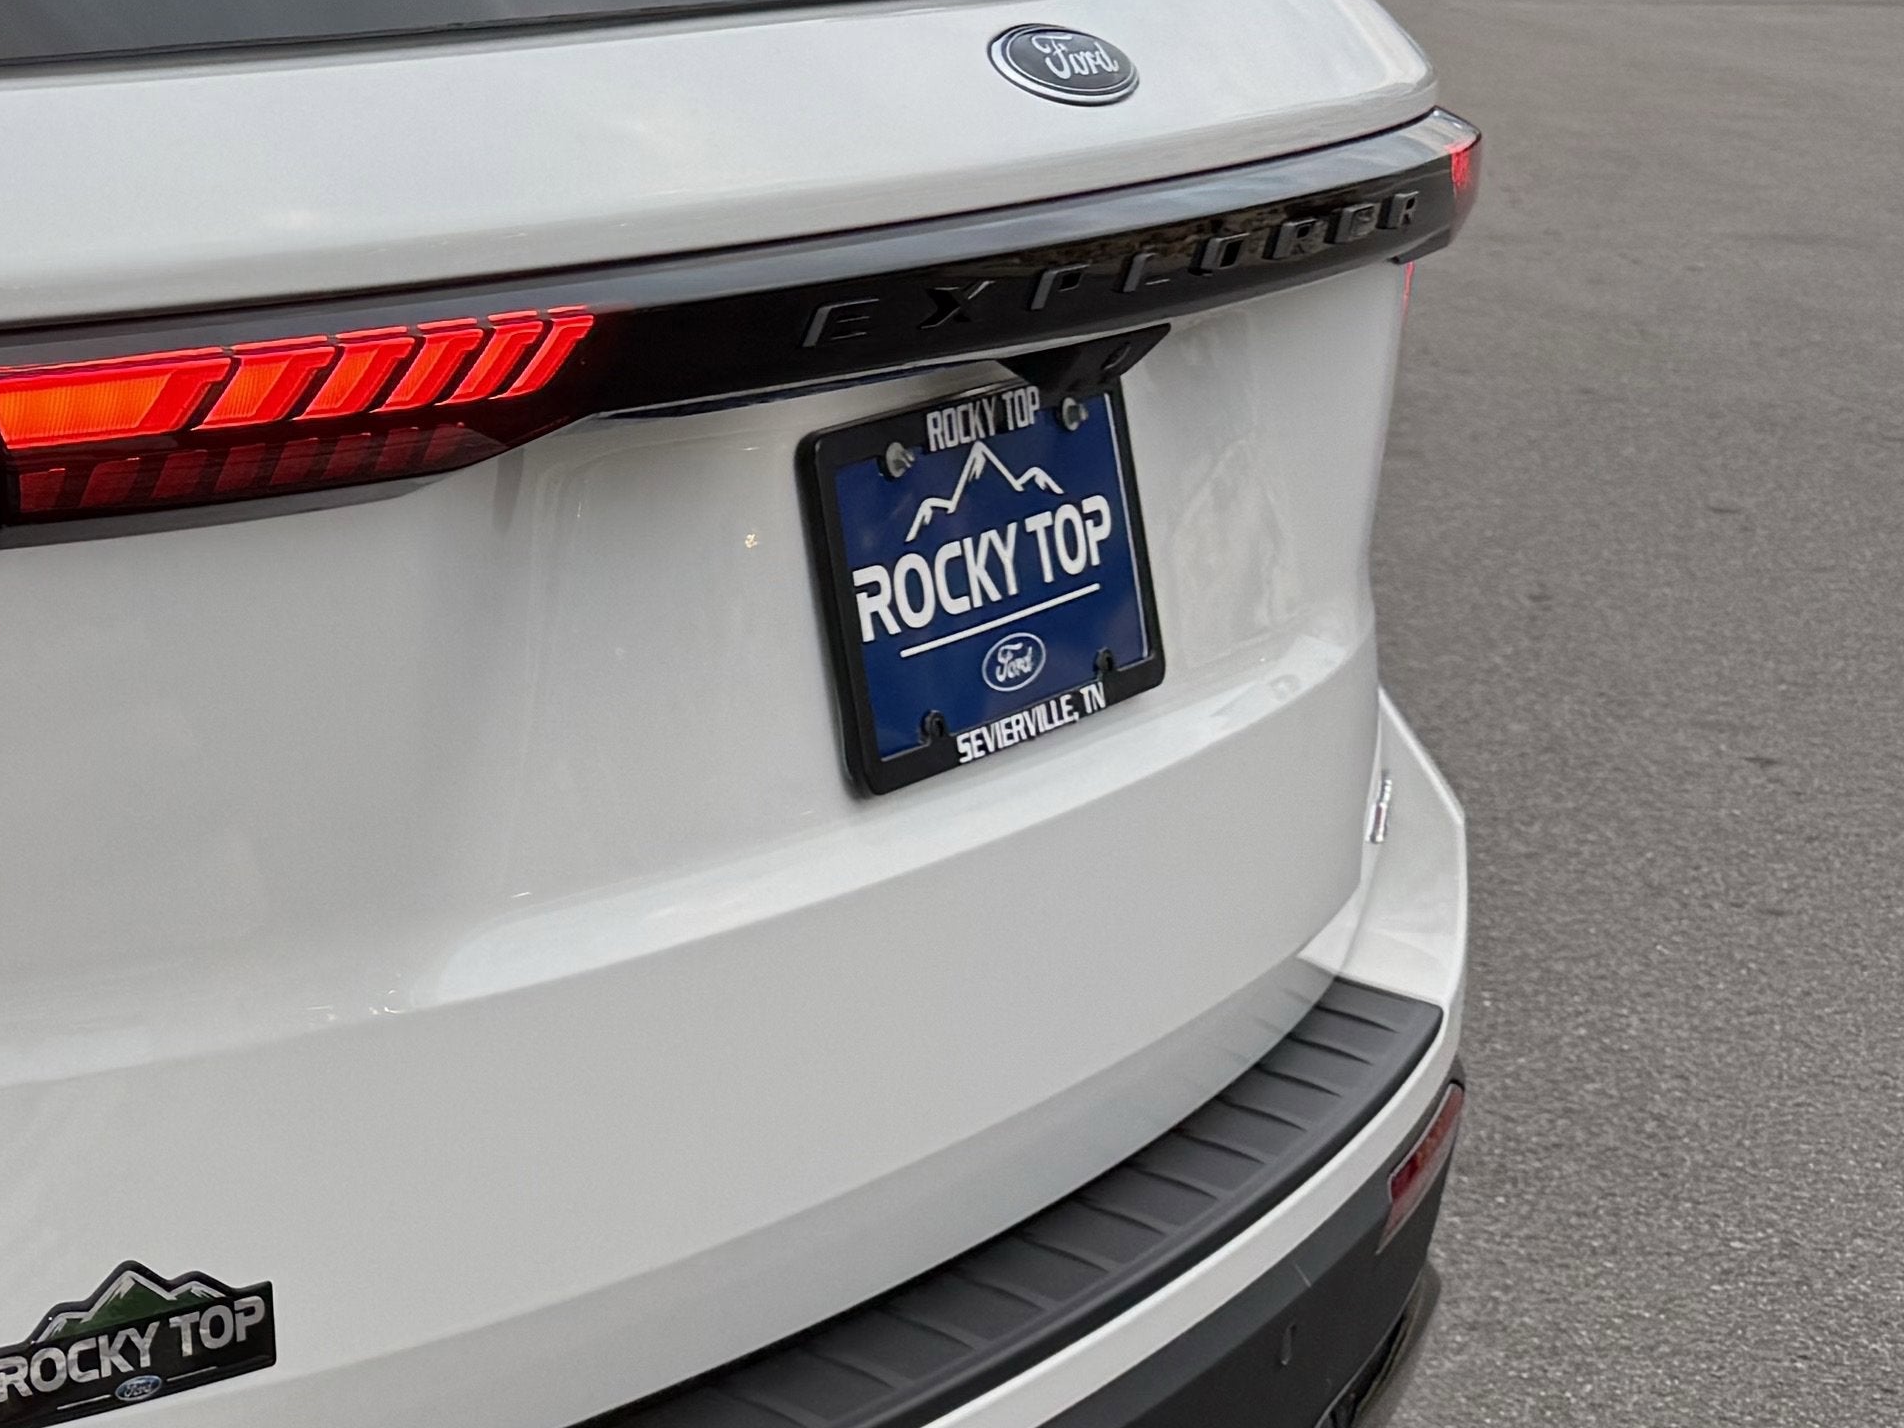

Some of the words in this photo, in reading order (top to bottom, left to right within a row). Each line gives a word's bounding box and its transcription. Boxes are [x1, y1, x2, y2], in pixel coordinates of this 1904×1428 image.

[1031, 34, 1120, 80] Ford
[800, 189, 1420, 349] EXPLORER
[926, 396, 996, 452] ROCKY
[1002, 385, 1040, 432] TOP
[852, 521, 1020, 643] ROCKY
[1024, 494, 1112, 584] TOP
[956, 694, 1080, 764] SEVIERVILLE,
[1079, 681, 1107, 714] TN
[169, 1295, 266, 1357] TOP
